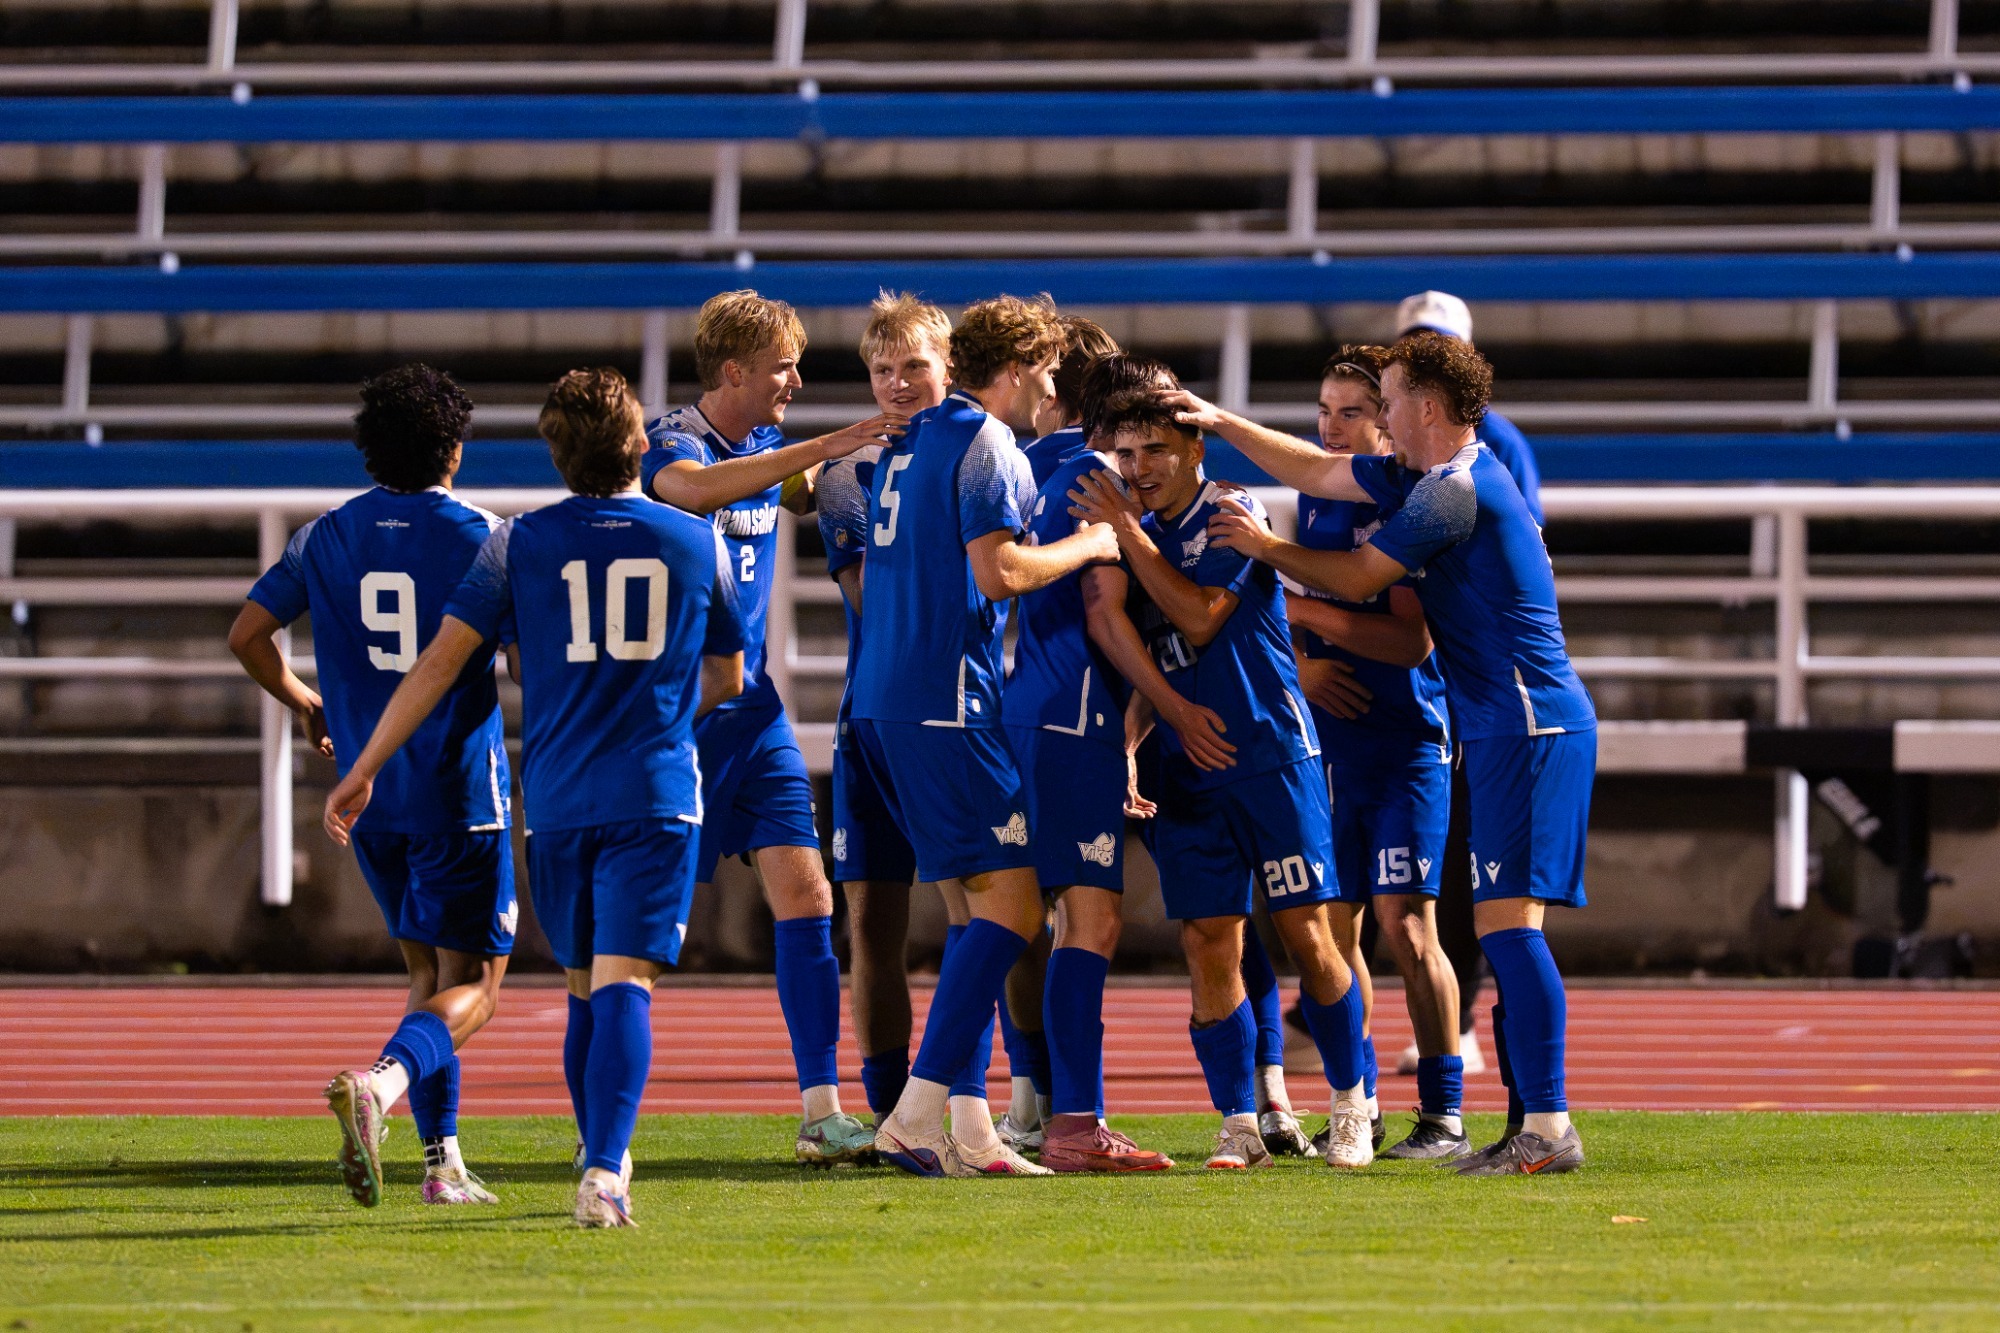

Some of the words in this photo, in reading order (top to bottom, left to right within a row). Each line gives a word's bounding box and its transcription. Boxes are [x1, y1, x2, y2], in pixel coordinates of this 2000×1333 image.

[874, 454, 914, 546] 5
[740, 545, 755, 581] 2
[1181, 557, 1200, 568] SOCC
[360, 571, 417, 673] 9
[561, 558, 669, 662] 10
[1157, 632, 1198, 672] 20
[1263, 855, 1309, 897] 20
[1378, 847, 1412, 885] 15
